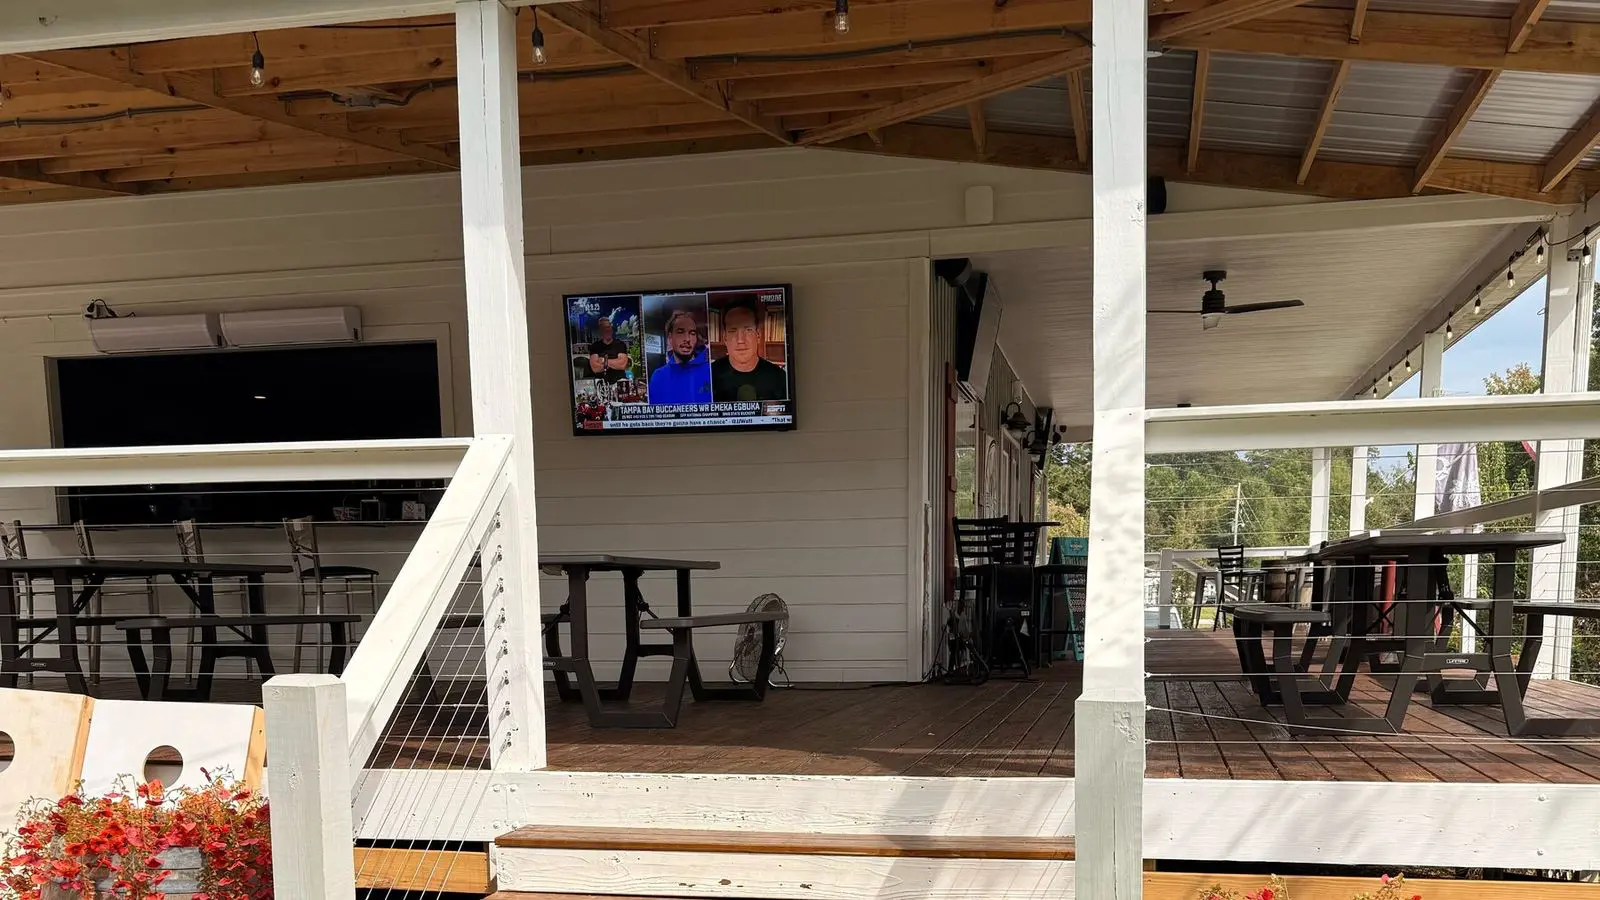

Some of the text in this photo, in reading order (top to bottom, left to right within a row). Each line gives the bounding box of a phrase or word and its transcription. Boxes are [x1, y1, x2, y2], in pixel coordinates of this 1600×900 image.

[620, 402, 760, 415] TAMPA BAY BUCCANEERS WR EMEKA EGBUKA
